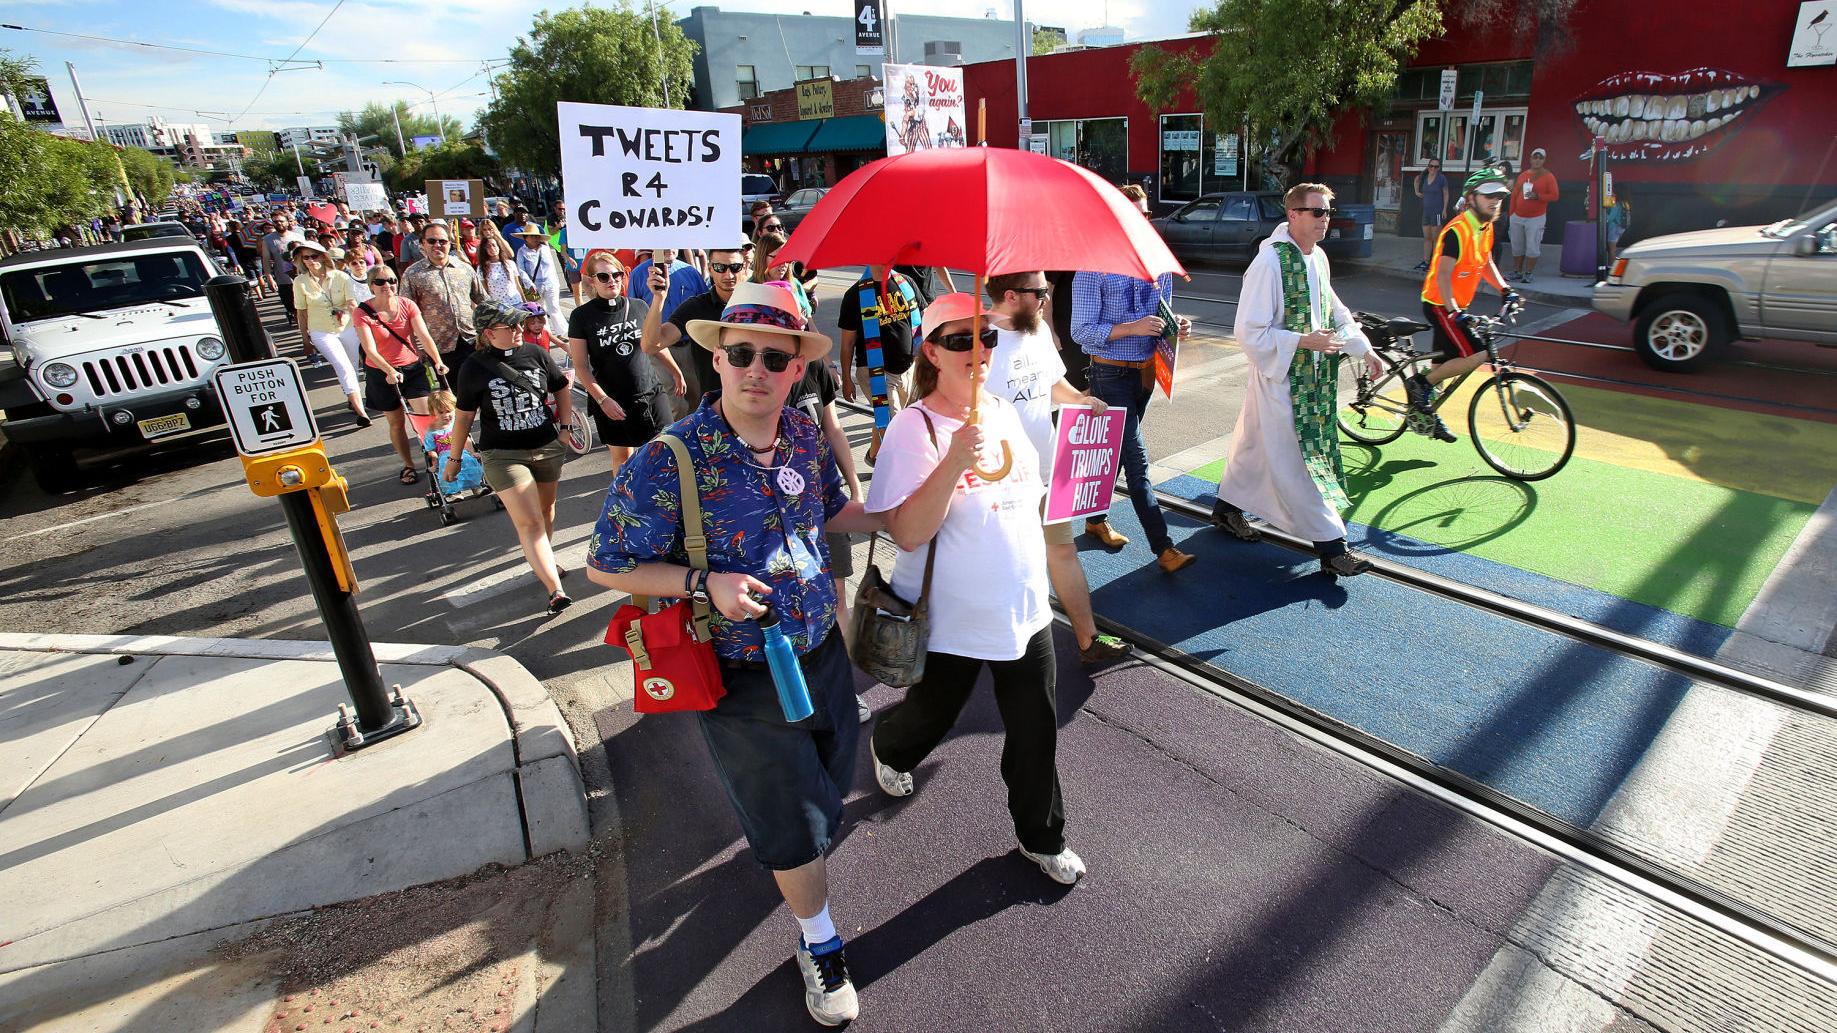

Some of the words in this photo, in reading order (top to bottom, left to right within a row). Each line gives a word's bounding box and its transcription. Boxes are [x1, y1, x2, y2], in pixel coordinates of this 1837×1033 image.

[924, 70, 957, 97] You
[928, 95, 963, 111] again?
[578, 124, 721, 163] TWEETS
[578, 199, 715, 232] COWARDS!
[596, 319, 637, 337] #STAY
[600, 329, 642, 347] WOKE
[234, 378, 286, 394] BUTTON
[238, 369, 275, 382] PUSH
[488, 367, 541, 399] SY
[250, 391, 277, 403] FOR
[1012, 388, 1047, 404] ALL
[1083, 415, 1112, 445] LOVE
[1070, 448, 1113, 480] TRUMPS
[1071, 480, 1102, 512] HATE
